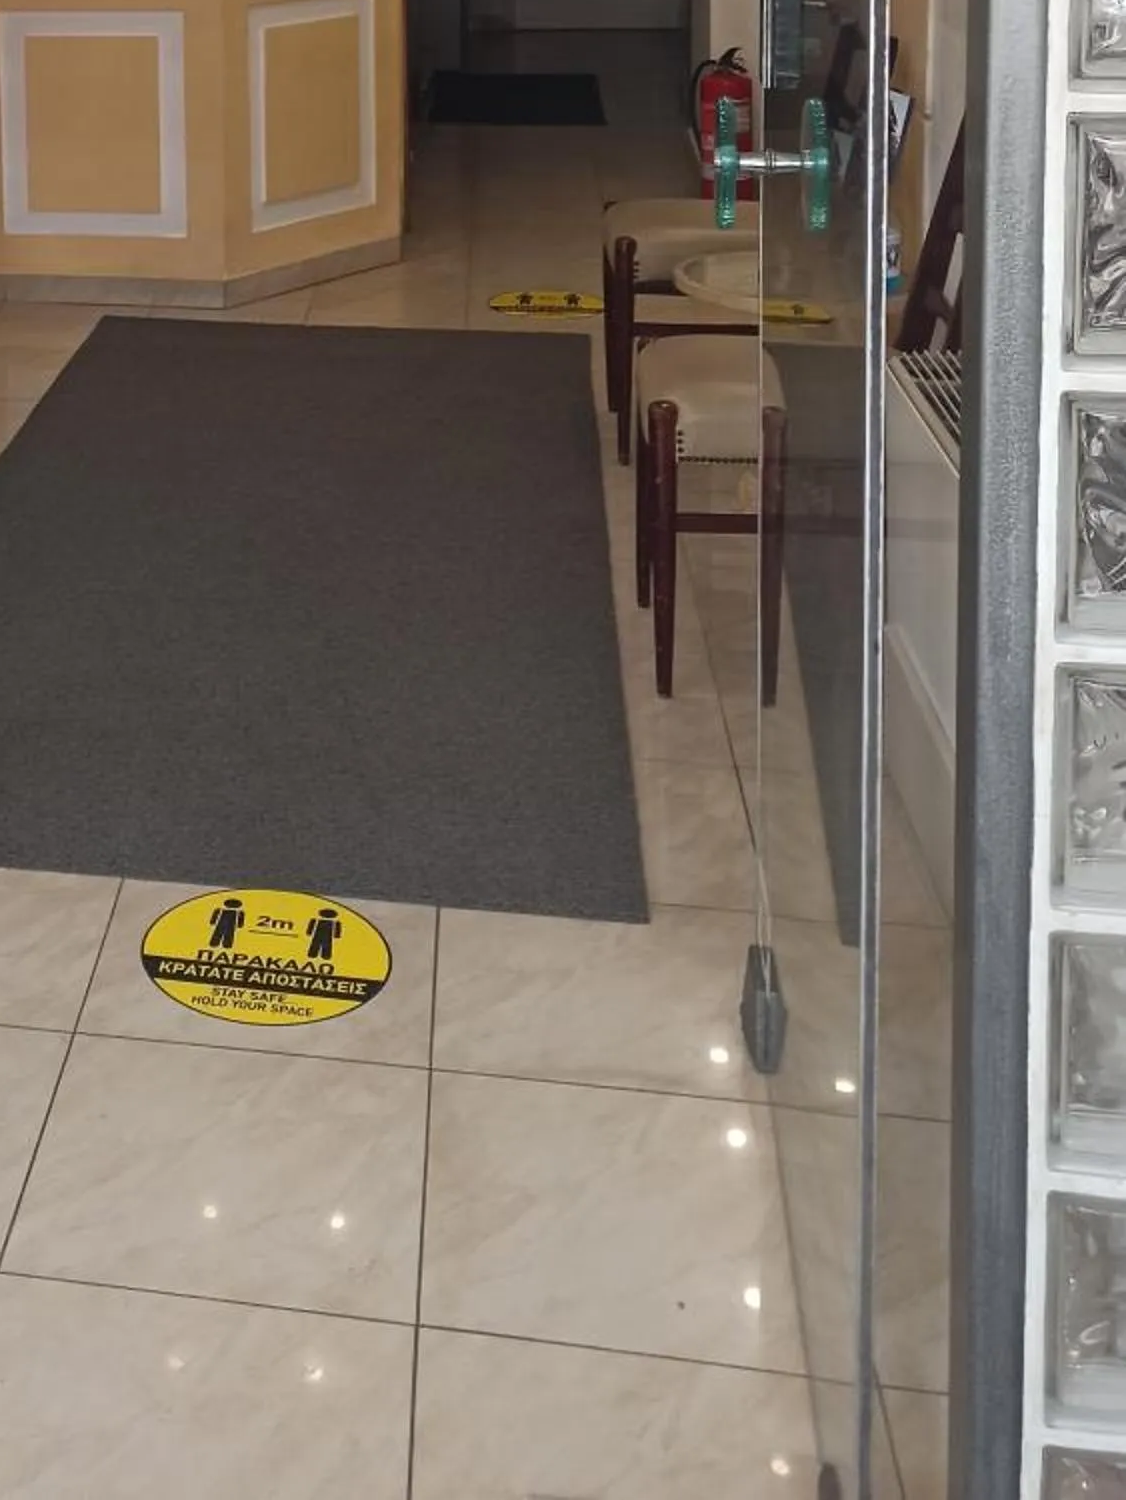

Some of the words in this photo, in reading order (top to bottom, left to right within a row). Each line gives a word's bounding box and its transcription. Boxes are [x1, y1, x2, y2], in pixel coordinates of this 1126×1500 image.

[256, 915, 294, 931] 2m
[197, 949, 335, 975] ΠΑΡΑΚΑΛΩ
[158, 960, 248, 981] ΚΡΑΤΑΤΕ
[250, 971, 367, 996] ΑΠΟΣΤΑΣΕΙΣ
[211, 986, 246, 998] STAY
[191, 995, 228, 1007] HOLD
[230, 998, 268, 1012] YOUR
[271, 1003, 314, 1017] SPACE
